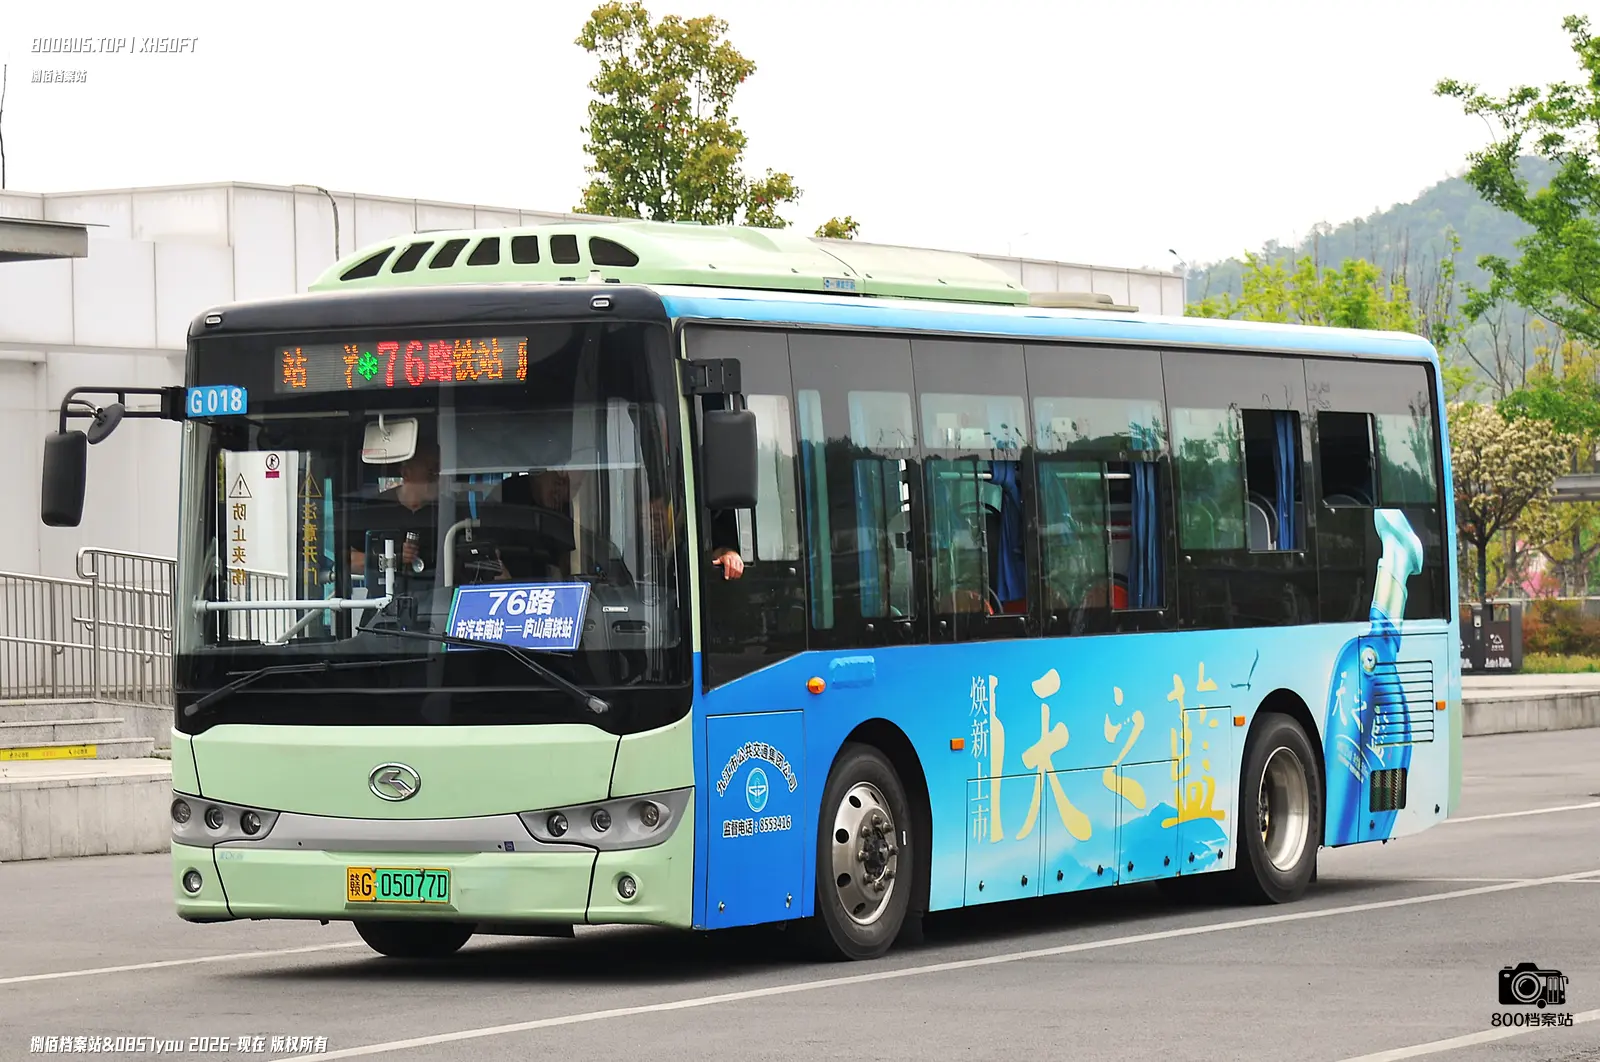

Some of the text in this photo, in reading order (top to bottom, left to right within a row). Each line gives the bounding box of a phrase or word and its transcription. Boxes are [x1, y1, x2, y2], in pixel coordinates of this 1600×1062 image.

[283, 347, 307, 388] 站
[488, 588, 555, 616] 76路
[716, 740, 798, 798] 九江市公共交通集团公司
[969, 675, 990, 844] 焕新上市
